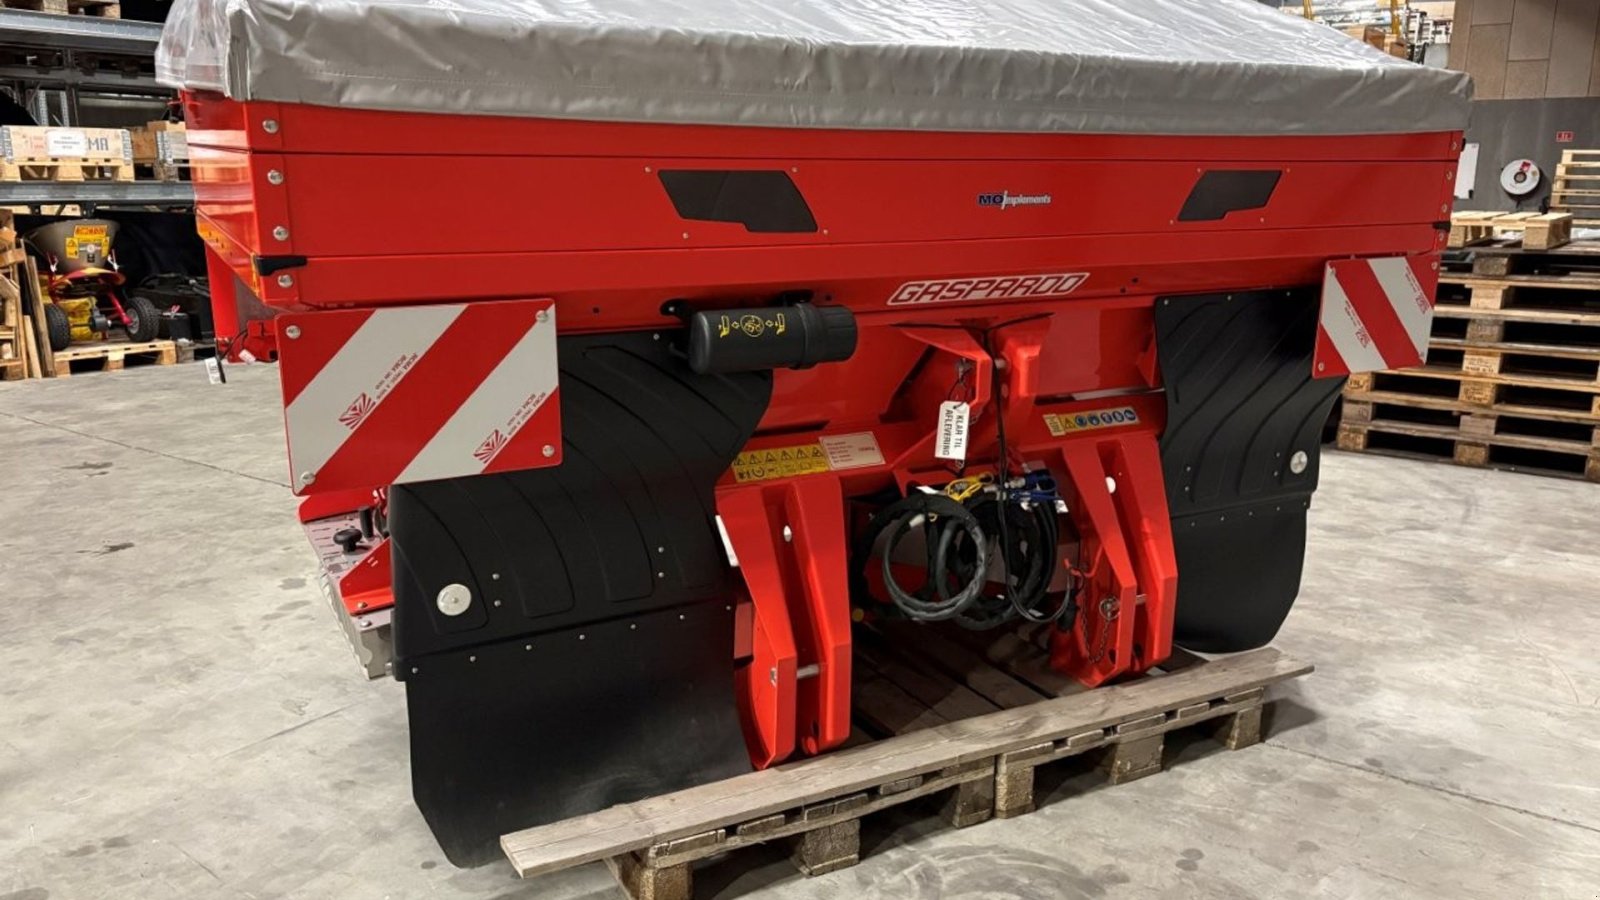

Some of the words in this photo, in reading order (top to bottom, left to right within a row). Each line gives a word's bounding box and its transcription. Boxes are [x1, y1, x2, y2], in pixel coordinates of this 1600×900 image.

[888, 274, 1087, 304] GASPARDO
[942, 409, 954, 456] AFLEVERING
[955, 414, 964, 436] KLAR
[954, 438, 962, 448] TIL
